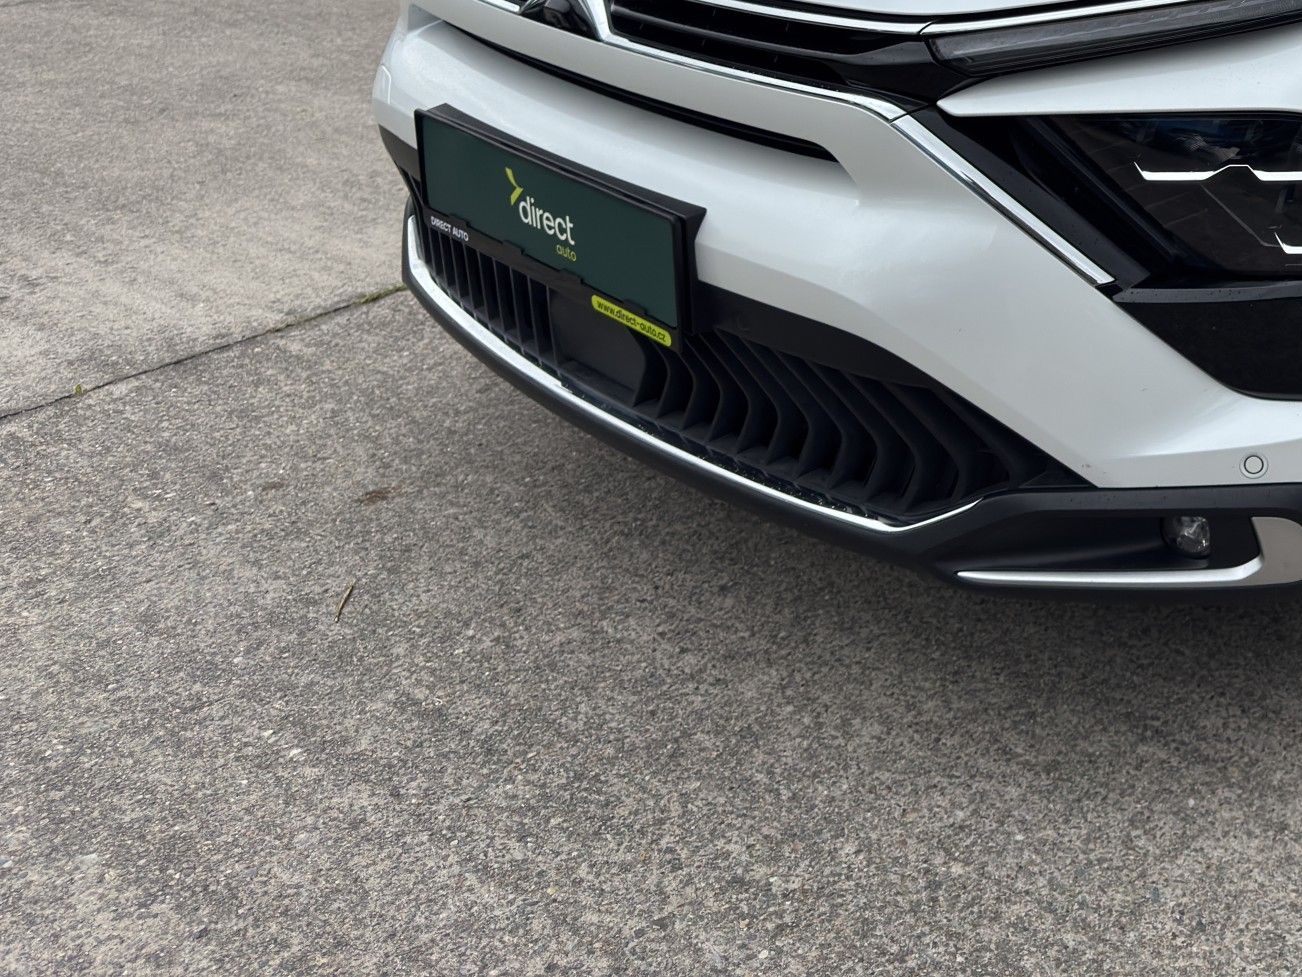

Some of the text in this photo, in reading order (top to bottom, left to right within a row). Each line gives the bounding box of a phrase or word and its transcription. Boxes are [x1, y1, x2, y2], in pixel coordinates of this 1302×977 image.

[430, 215, 469, 242] DIRECT AUTO
[519, 195, 575, 245] direct
[556, 244, 577, 262] auto
[596, 300, 667, 342] www.direct-auto.cz
